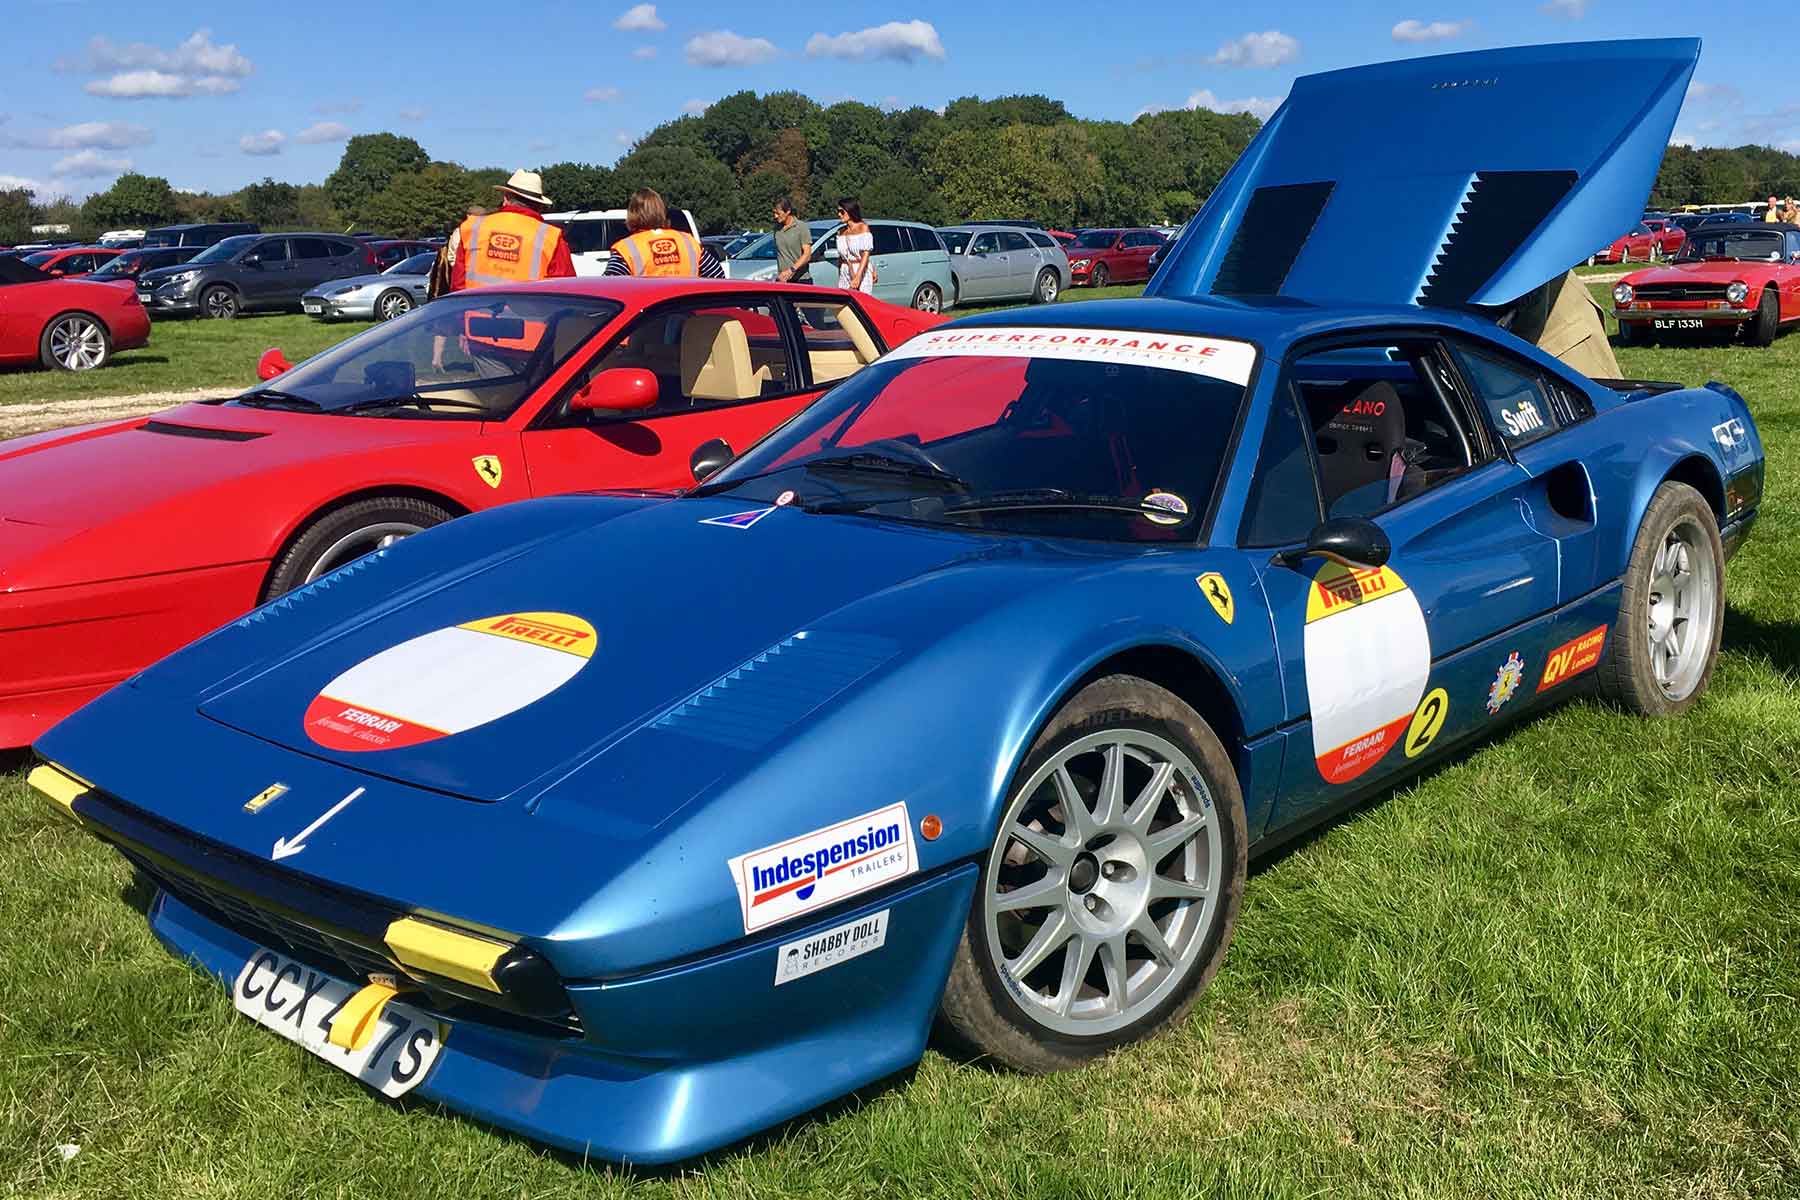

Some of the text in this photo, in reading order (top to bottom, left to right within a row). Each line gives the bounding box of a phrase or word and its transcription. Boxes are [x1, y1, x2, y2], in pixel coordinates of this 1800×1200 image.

[488, 248, 518, 262] events
[495, 236, 515, 249] SEP
[655, 241, 673, 252] SEP
[1654, 319, 1704, 329] BLF 133H
[927, 333, 1220, 357] SUPERFORMANCE
[1501, 400, 1544, 436] Swift
[1317, 567, 1387, 609] PIRELLI
[488, 616, 591, 647] PIRELLI
[1543, 646, 1577, 684] QV
[336, 707, 404, 733] FERRARI
[1410, 697, 1441, 751] 2
[1343, 730, 1386, 760] FERRARI
[752, 823, 900, 892] Indespension
[851, 851, 904, 879] TRAILERS
[802, 935, 879, 969] RECORDS
[803, 918, 880, 960] SHABBY DOLL
[242, 951, 434, 1084] CCX 47S
